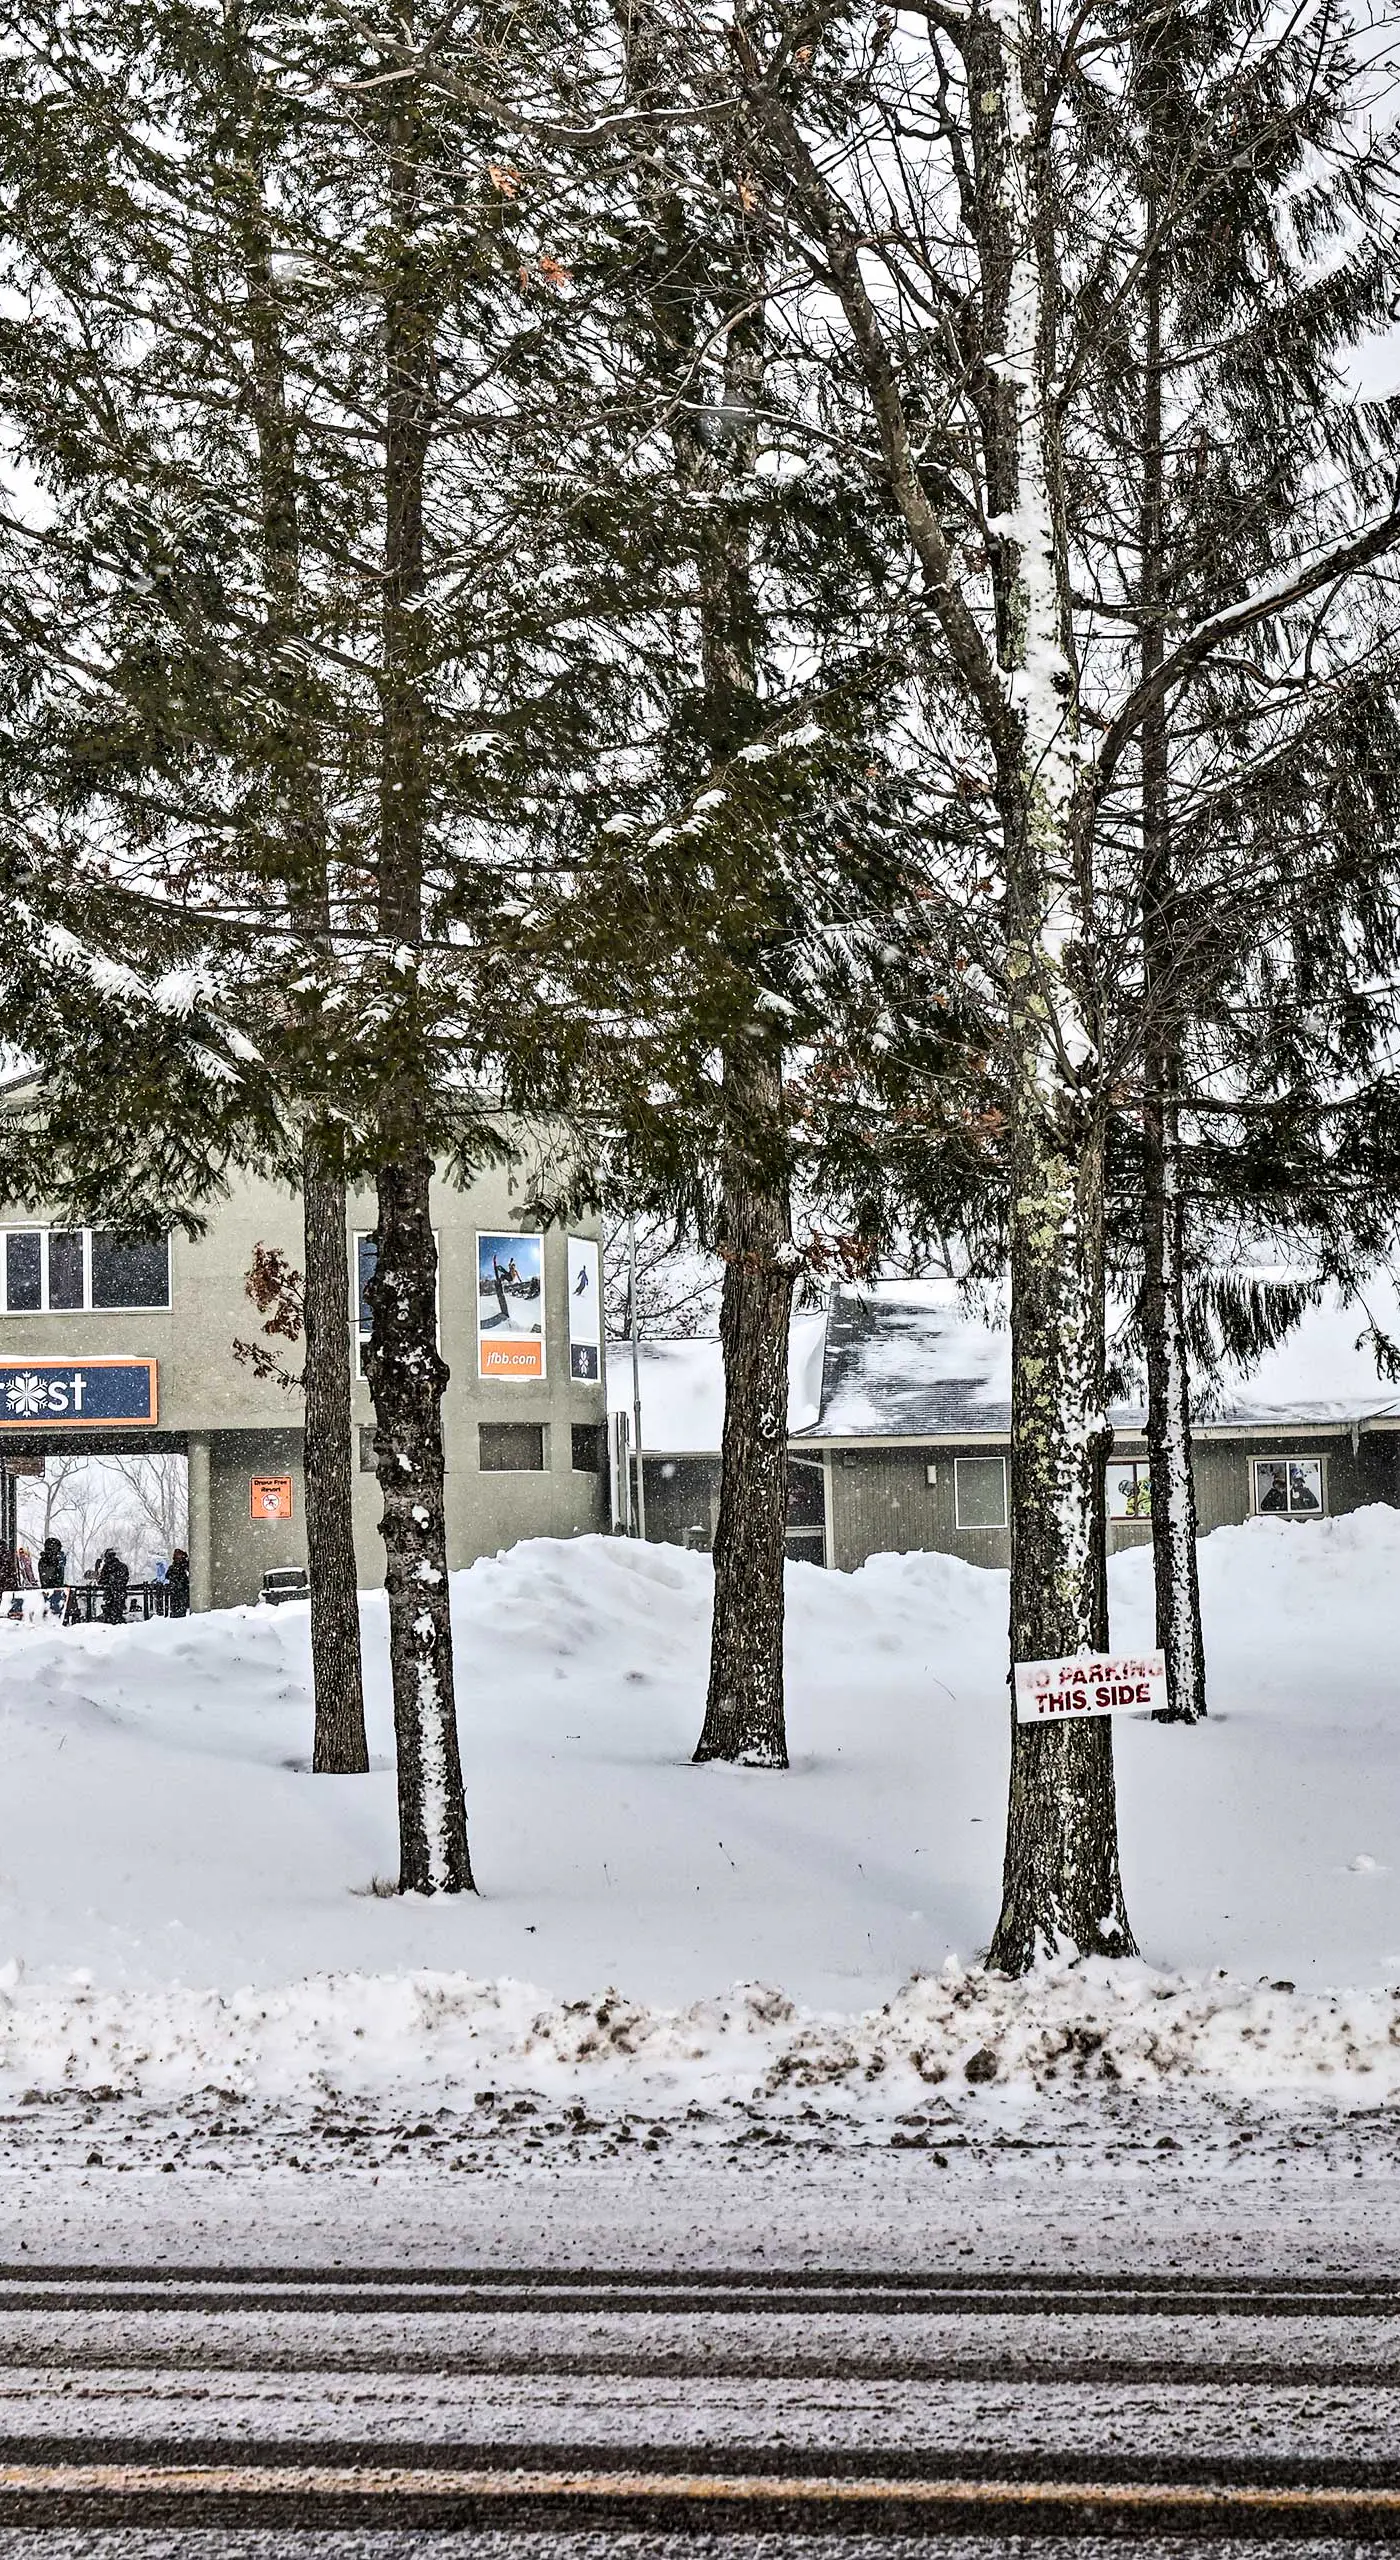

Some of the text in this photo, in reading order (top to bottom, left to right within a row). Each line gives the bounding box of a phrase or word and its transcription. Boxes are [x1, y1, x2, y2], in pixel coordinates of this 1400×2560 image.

[487, 1352, 536, 1368] jfbb.com
[1058, 1658, 1164, 1687] PARKING
[1036, 1683, 1151, 1713] THIS SIDE
